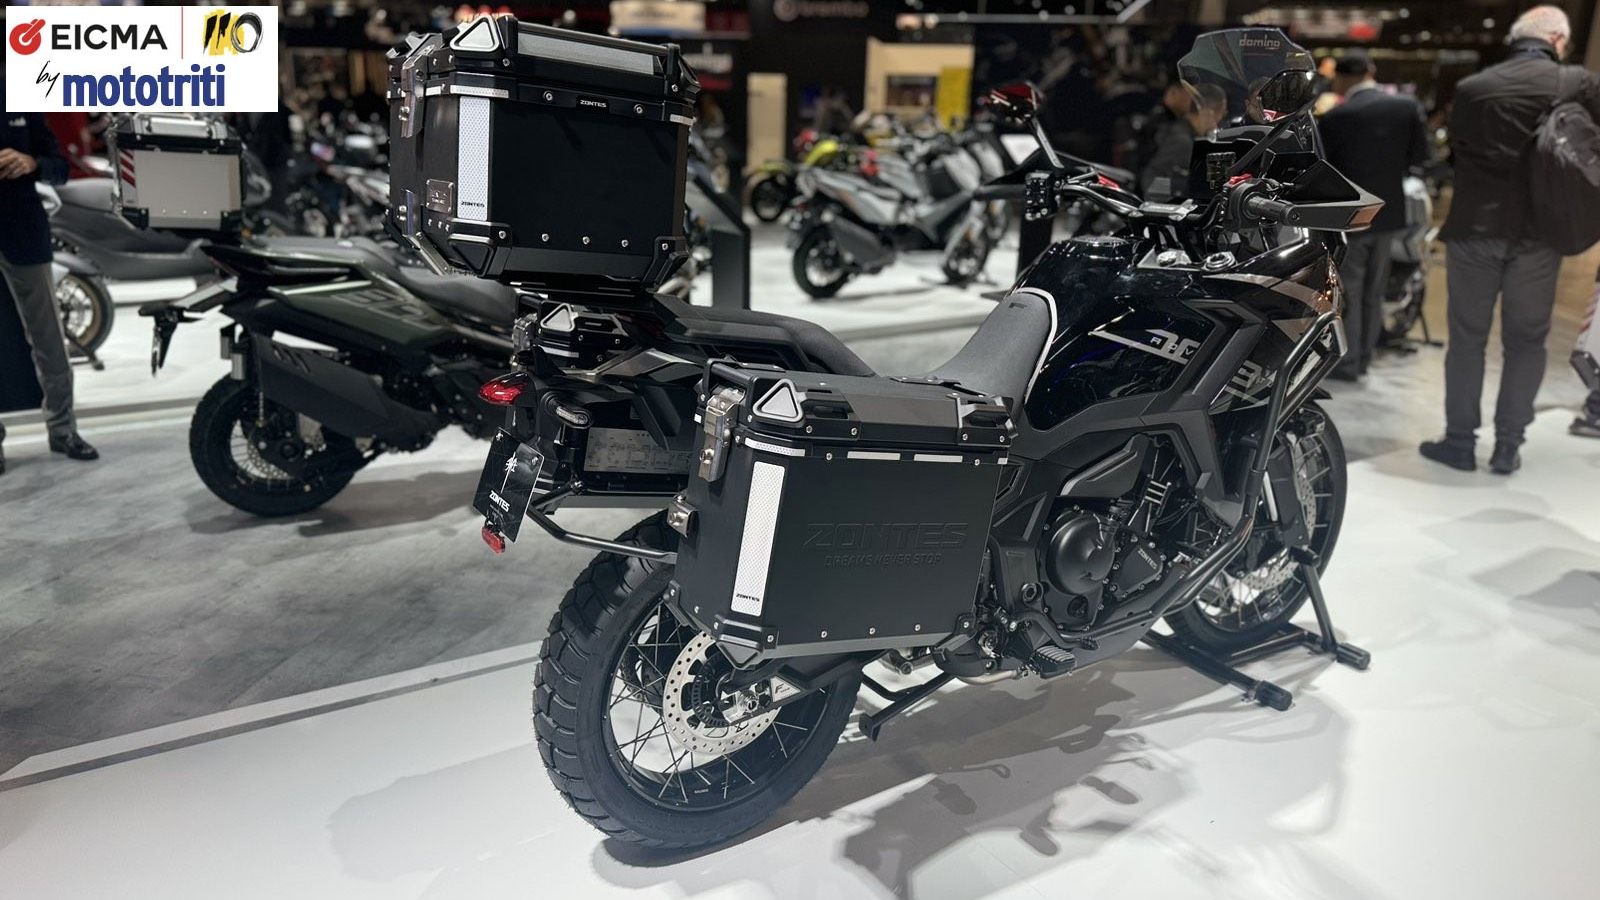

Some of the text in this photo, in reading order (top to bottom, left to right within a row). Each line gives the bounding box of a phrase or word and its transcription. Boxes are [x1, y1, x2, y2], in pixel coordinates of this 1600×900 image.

[1239, 33, 1281, 47] domino
[580, 99, 607, 108] ZONTES
[461, 200, 485, 208] ZONTES
[490, 490, 511, 512] ZONTES
[802, 522, 968, 549] ZONTES
[824, 552, 943, 568] DREAMS NEVER STOP
[736, 593, 760, 601] ZONTES
